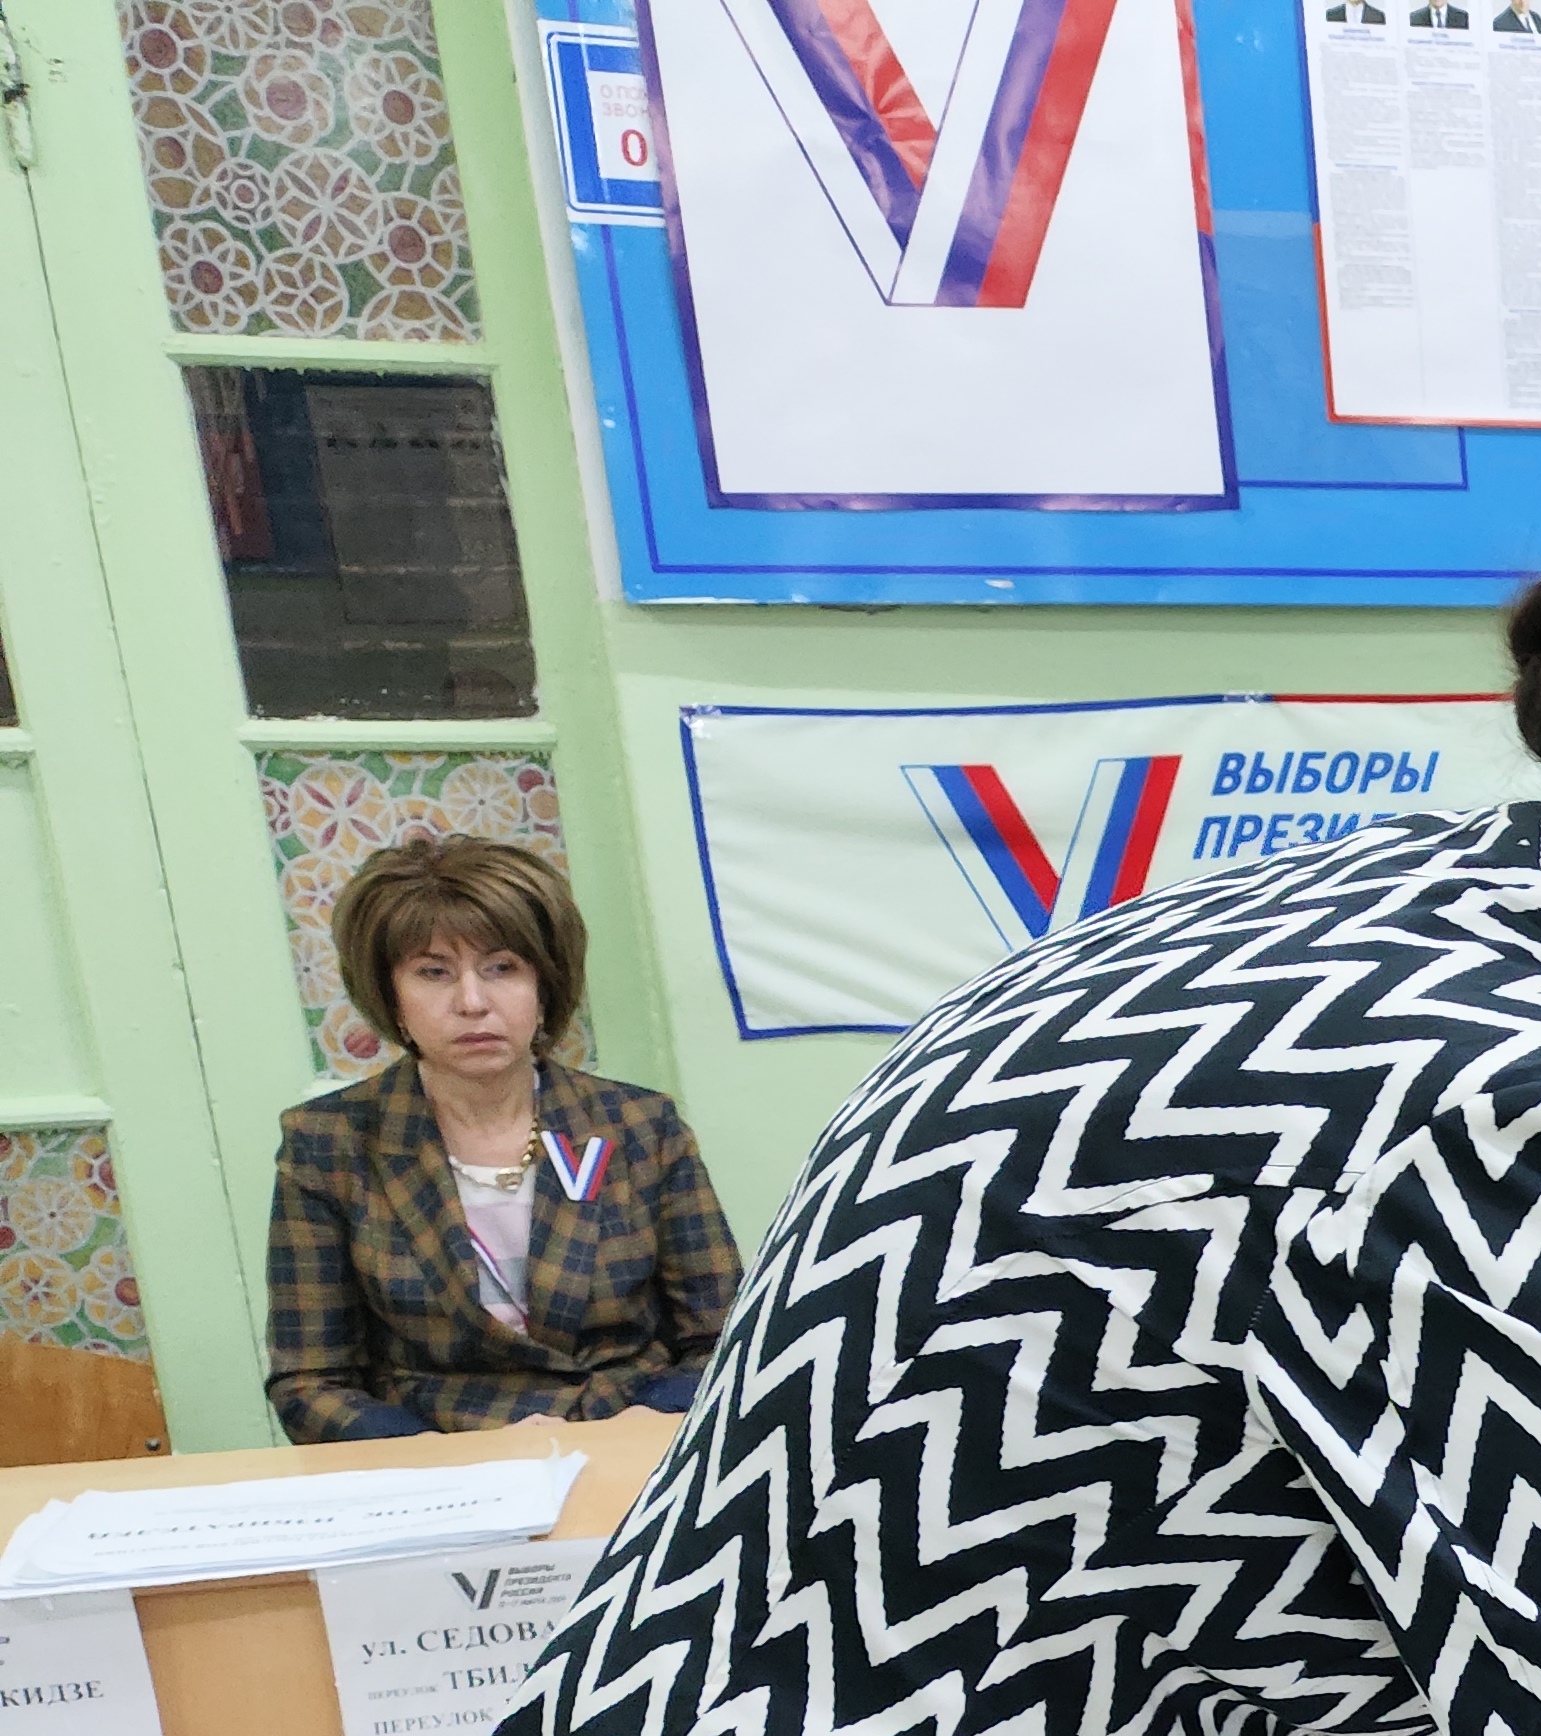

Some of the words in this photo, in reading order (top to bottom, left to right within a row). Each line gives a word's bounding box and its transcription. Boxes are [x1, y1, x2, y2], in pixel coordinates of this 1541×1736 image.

[1211, 750, 1440, 796] ВЫБОРЫ
[362, 1641, 407, 1665] ул.
[374, 1706, 495, 1736] ПЕРЕУЛОК
